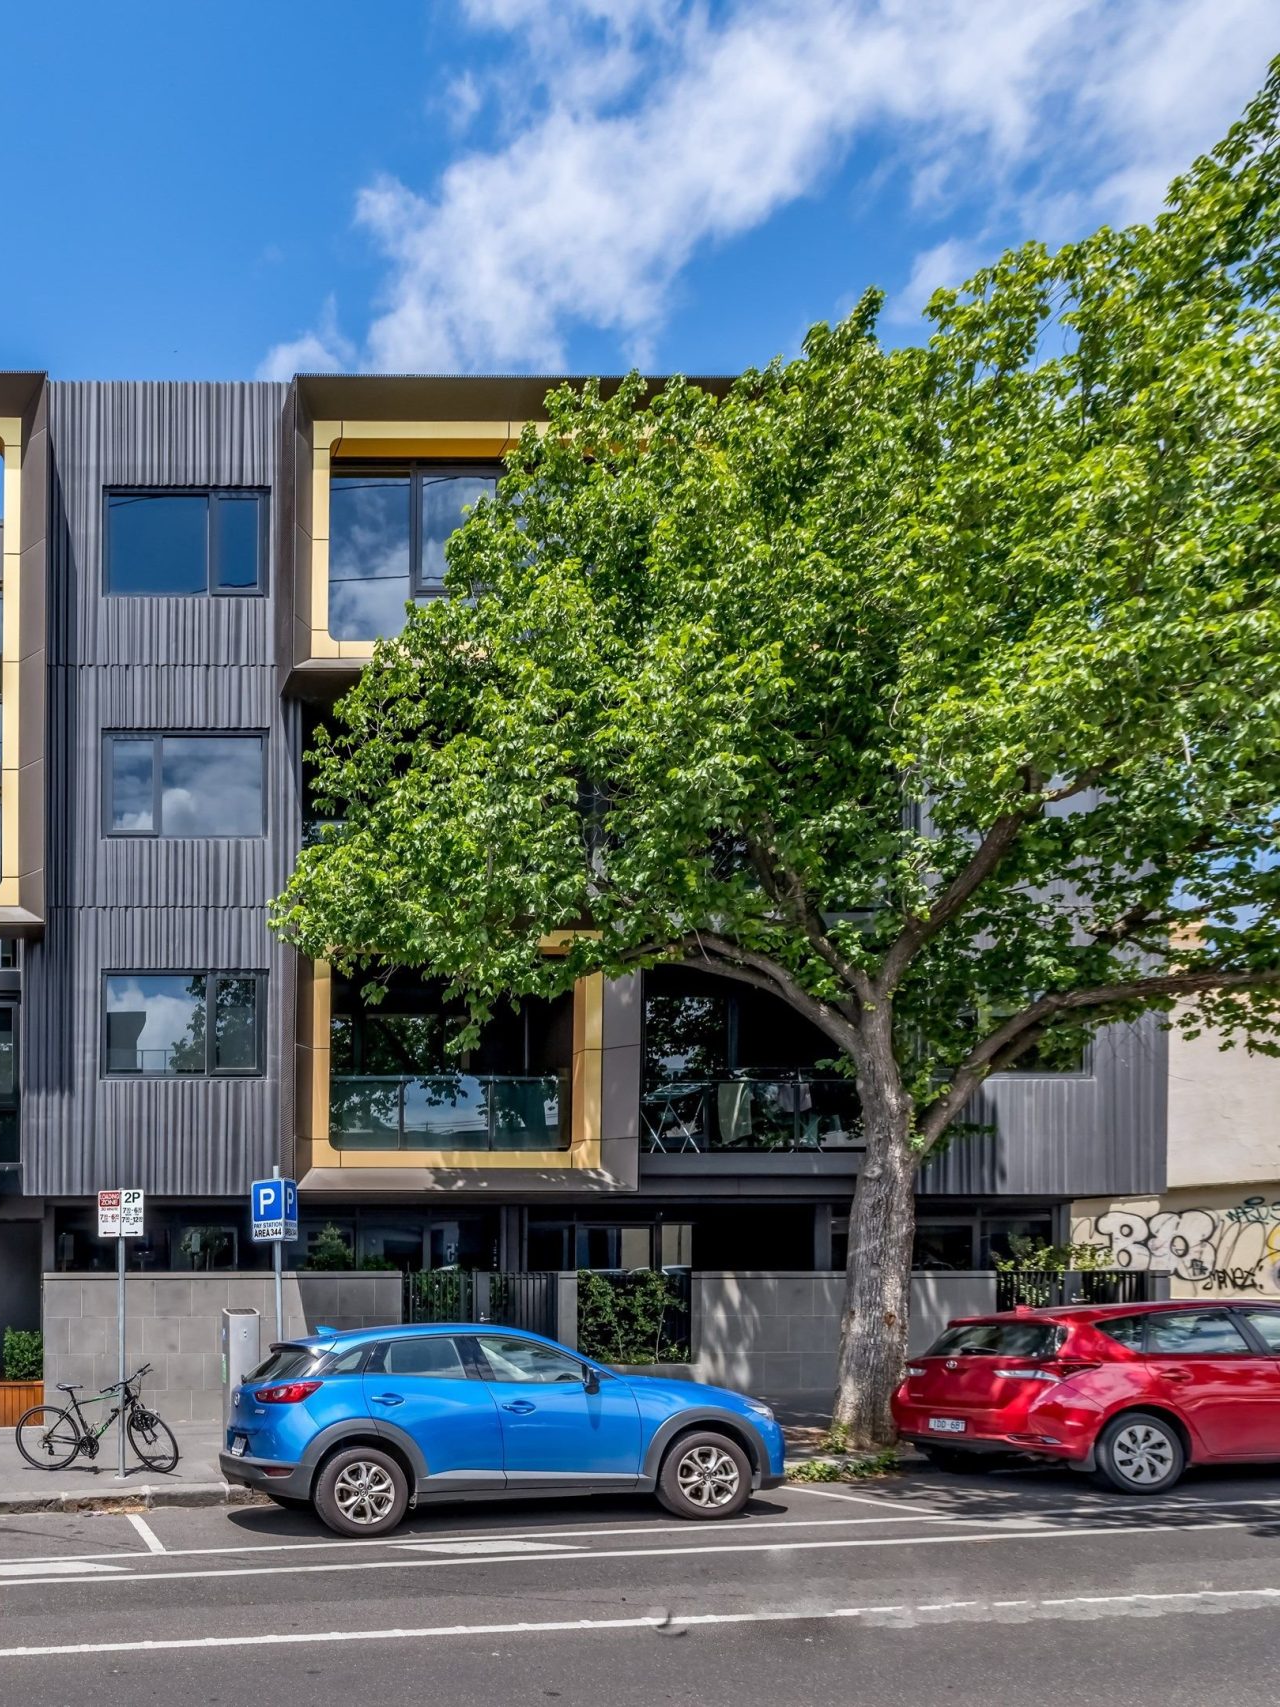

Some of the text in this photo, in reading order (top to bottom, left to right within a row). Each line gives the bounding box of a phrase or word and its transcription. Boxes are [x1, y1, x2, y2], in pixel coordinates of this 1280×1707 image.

[124, 1192, 141, 1203] 2P
[259, 1188, 275, 1215] P
[287, 1188, 294, 1214] P
[254, 1228, 270, 1238] AREA
[270, 1227, 282, 1236] 344
